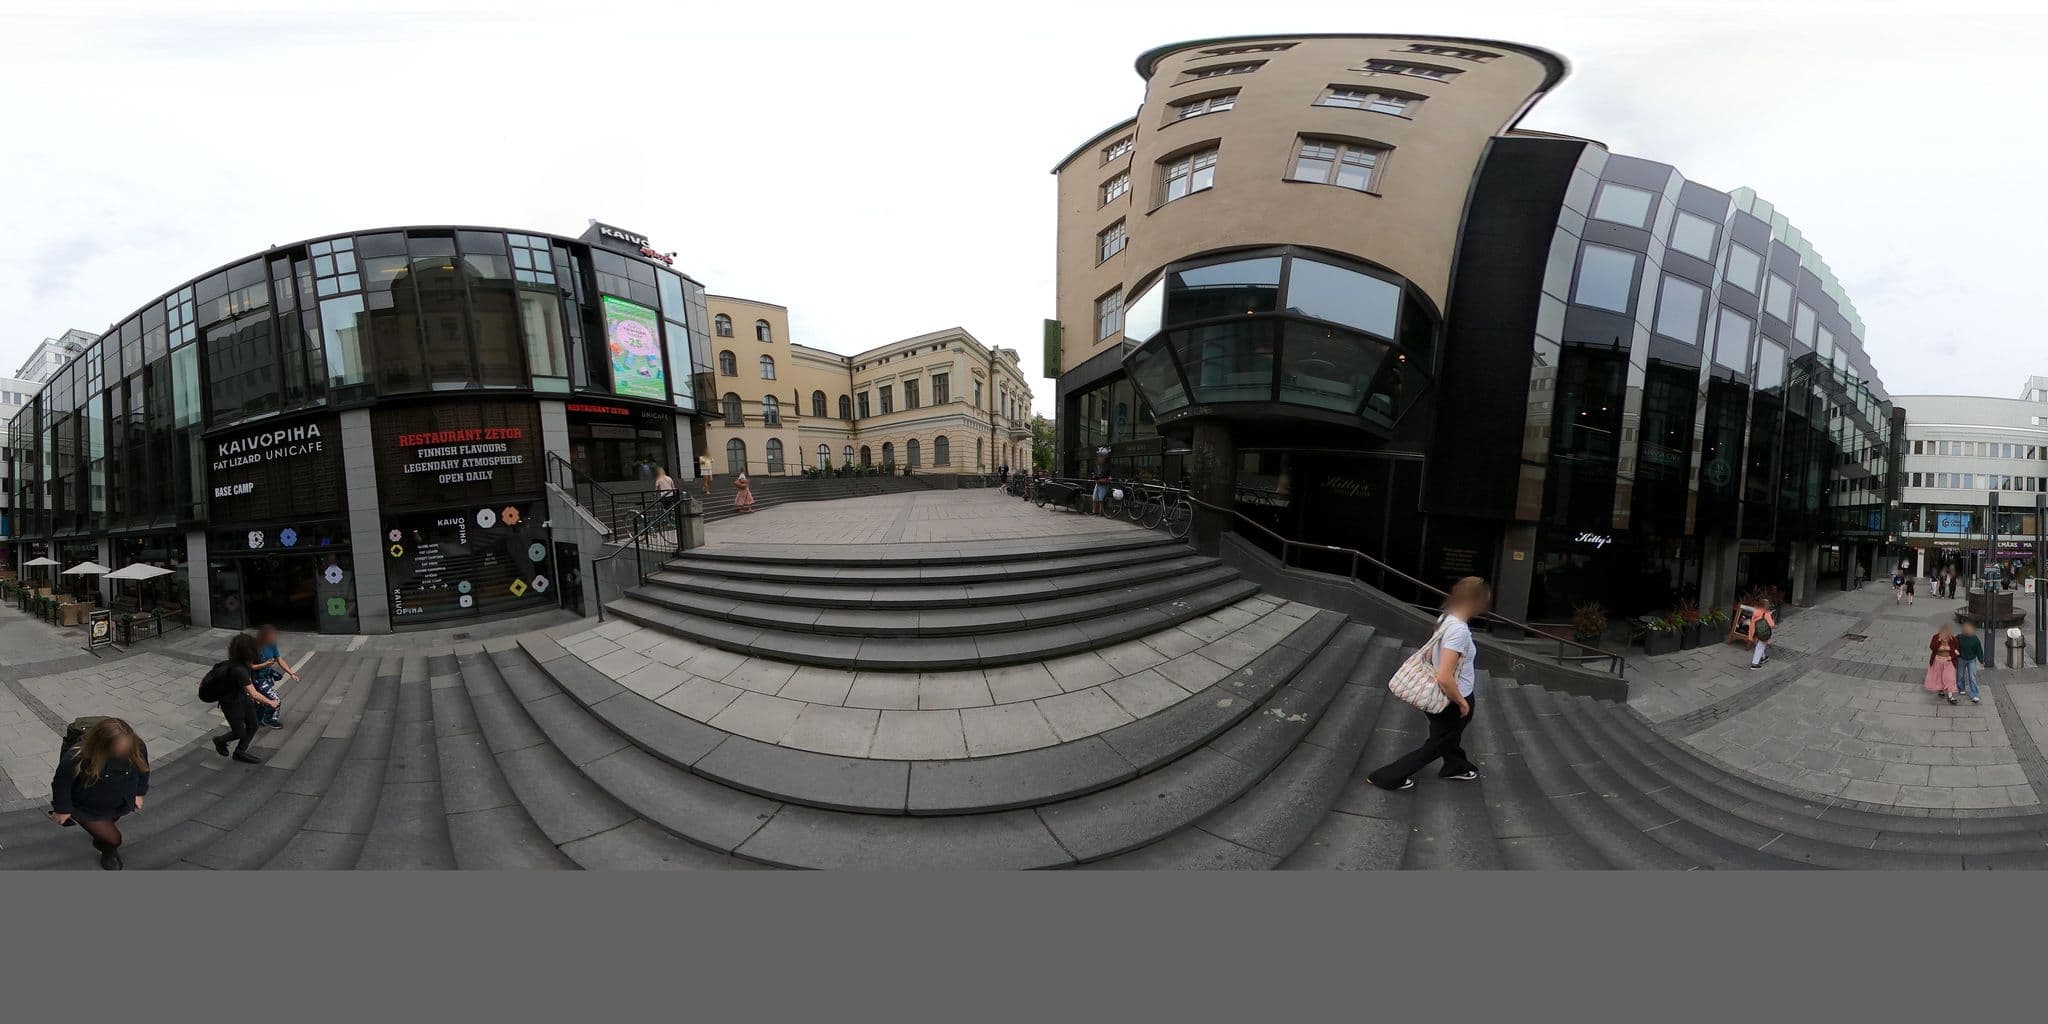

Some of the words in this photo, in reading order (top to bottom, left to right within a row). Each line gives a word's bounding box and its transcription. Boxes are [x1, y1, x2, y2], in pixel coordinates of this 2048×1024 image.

[601, 227, 650, 248] KAIVO
[219, 424, 321, 457] KAIVOPIHA
[400, 429, 482, 447] RESTAURANT
[485, 428, 522, 440] ZETOR
[265, 441, 322, 460] UNICAFE
[418, 446, 457, 458] FINNISH
[459, 443, 507, 455] FLAVOURS
[213, 460, 228, 471] FAT
[229, 454, 261, 467] LIZARD
[404, 459, 459, 473] LEGENDARY
[462, 455, 523, 468] ATMOSPHERE
[439, 473, 464, 484] OPEN
[466, 470, 493, 481] DAILY
[214, 486, 233, 497] BASE
[233, 482, 254, 495] CAMP
[1575, 532, 1611, 549] Kitty's
